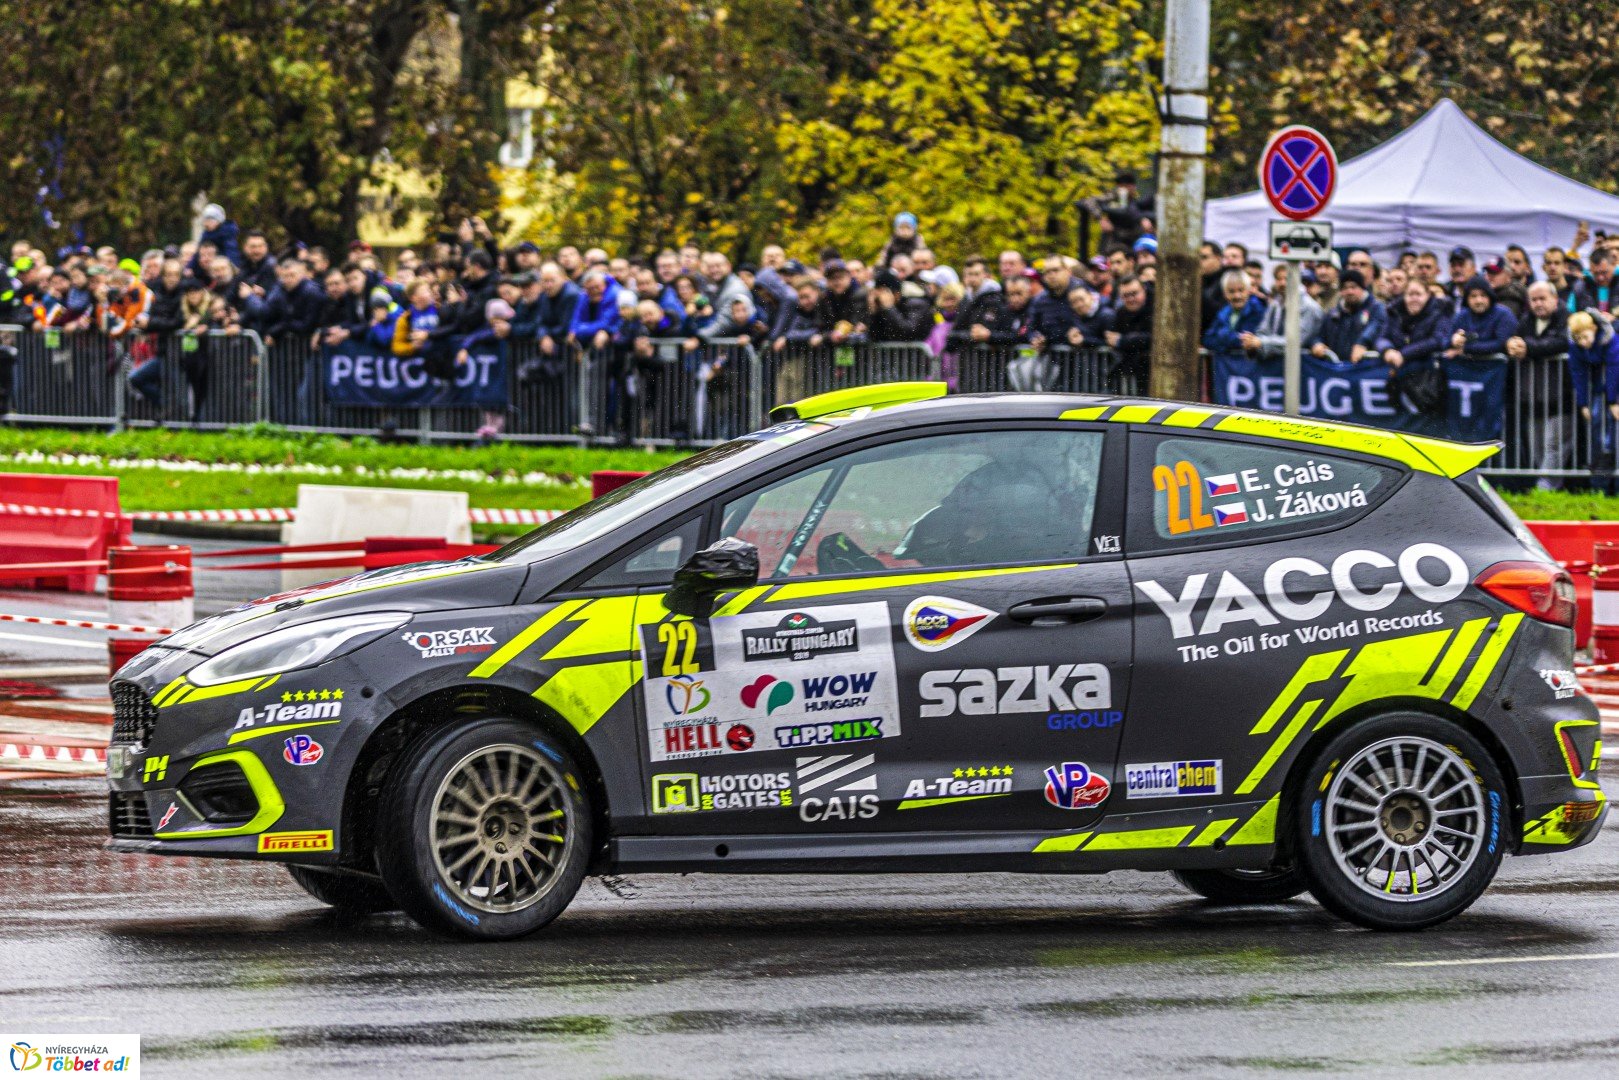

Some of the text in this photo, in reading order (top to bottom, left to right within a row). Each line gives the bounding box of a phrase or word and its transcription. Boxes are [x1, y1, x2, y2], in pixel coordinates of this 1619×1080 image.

[330, 354, 498, 389] PEUGOT
[1227, 375, 1484, 418] PEUGET
[1240, 460, 1335, 493] E. Cais
[1152, 460, 1215, 535] 22
[1251, 483, 1368, 523] J. Žáková
[1134, 543, 1469, 639] YACCO
[658, 620, 700, 677] 22
[746, 636, 788, 655] RALLY
[791, 627, 855, 650] HUNGARY
[1177, 610, 1444, 663] The Oil for World Records
[803, 671, 877, 700] WOW
[234, 702, 342, 730] A-Team
[805, 696, 868, 713] HUNGARY
[1047, 711, 1123, 730] GROUP
[284, 735, 312, 764] VP
[665, 724, 722, 752] HELL
[701, 772, 791, 793] MOTORS
[903, 776, 1013, 798] A-Team
[1044, 762, 1091, 808] VP
[713, 790, 780, 809] GATES
[800, 795, 880, 822] CAIS
[263, 834, 328, 850] PIRELLI
